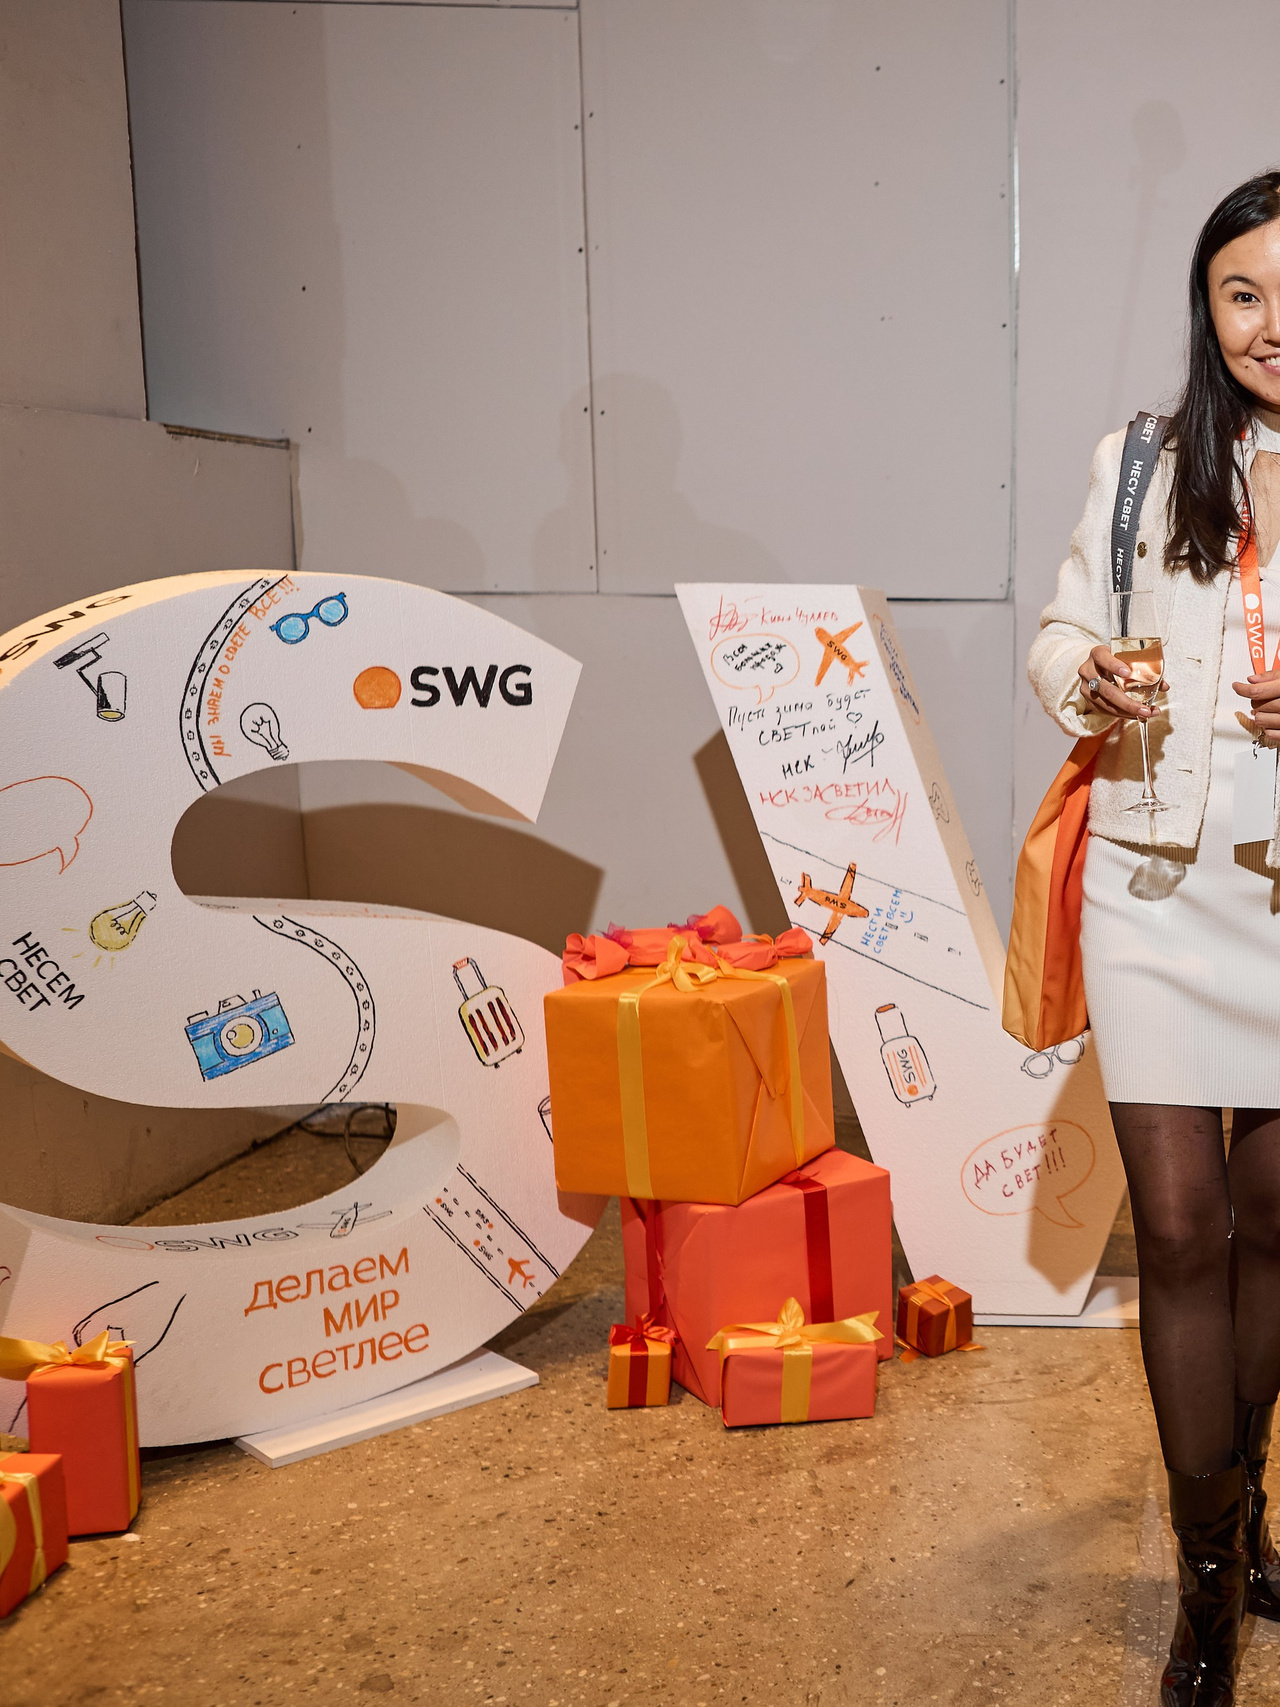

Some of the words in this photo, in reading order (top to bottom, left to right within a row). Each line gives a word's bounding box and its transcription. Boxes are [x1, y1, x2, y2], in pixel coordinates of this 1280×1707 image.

[1128, 460, 1143, 496] НЕСУ
[1120, 498, 1134, 531] СВЕТ
[1115, 548, 1125, 583] НЕСУ
[827, 640, 848, 661] SWG
[1247, 612, 1263, 659] SWG
[218, 665, 230, 675] О
[410, 664, 533, 708] SWG
[207, 678, 224, 726] ЗНАЕМ
[210, 735, 232, 757] МЫ
[825, 896, 847, 909] SWG
[873, 926, 889, 954] СВЕТ
[886, 889, 902, 920] ВСЕМ
[860, 907, 884, 947] НЕСТИ
[0, 958, 51, 1011] СВЕТ
[12, 931, 85, 1010] НЕСЕМ
[896, 1048, 916, 1084] SWG
[973, 1159, 997, 1190] ДА
[1000, 1128, 1059, 1170] БУДЕТ
[155, 1227, 300, 1252] SWG
[478, 1245, 494, 1260] SWG
[244, 1247, 410, 1317] делаем
[258, 1323, 430, 1394] светлее
